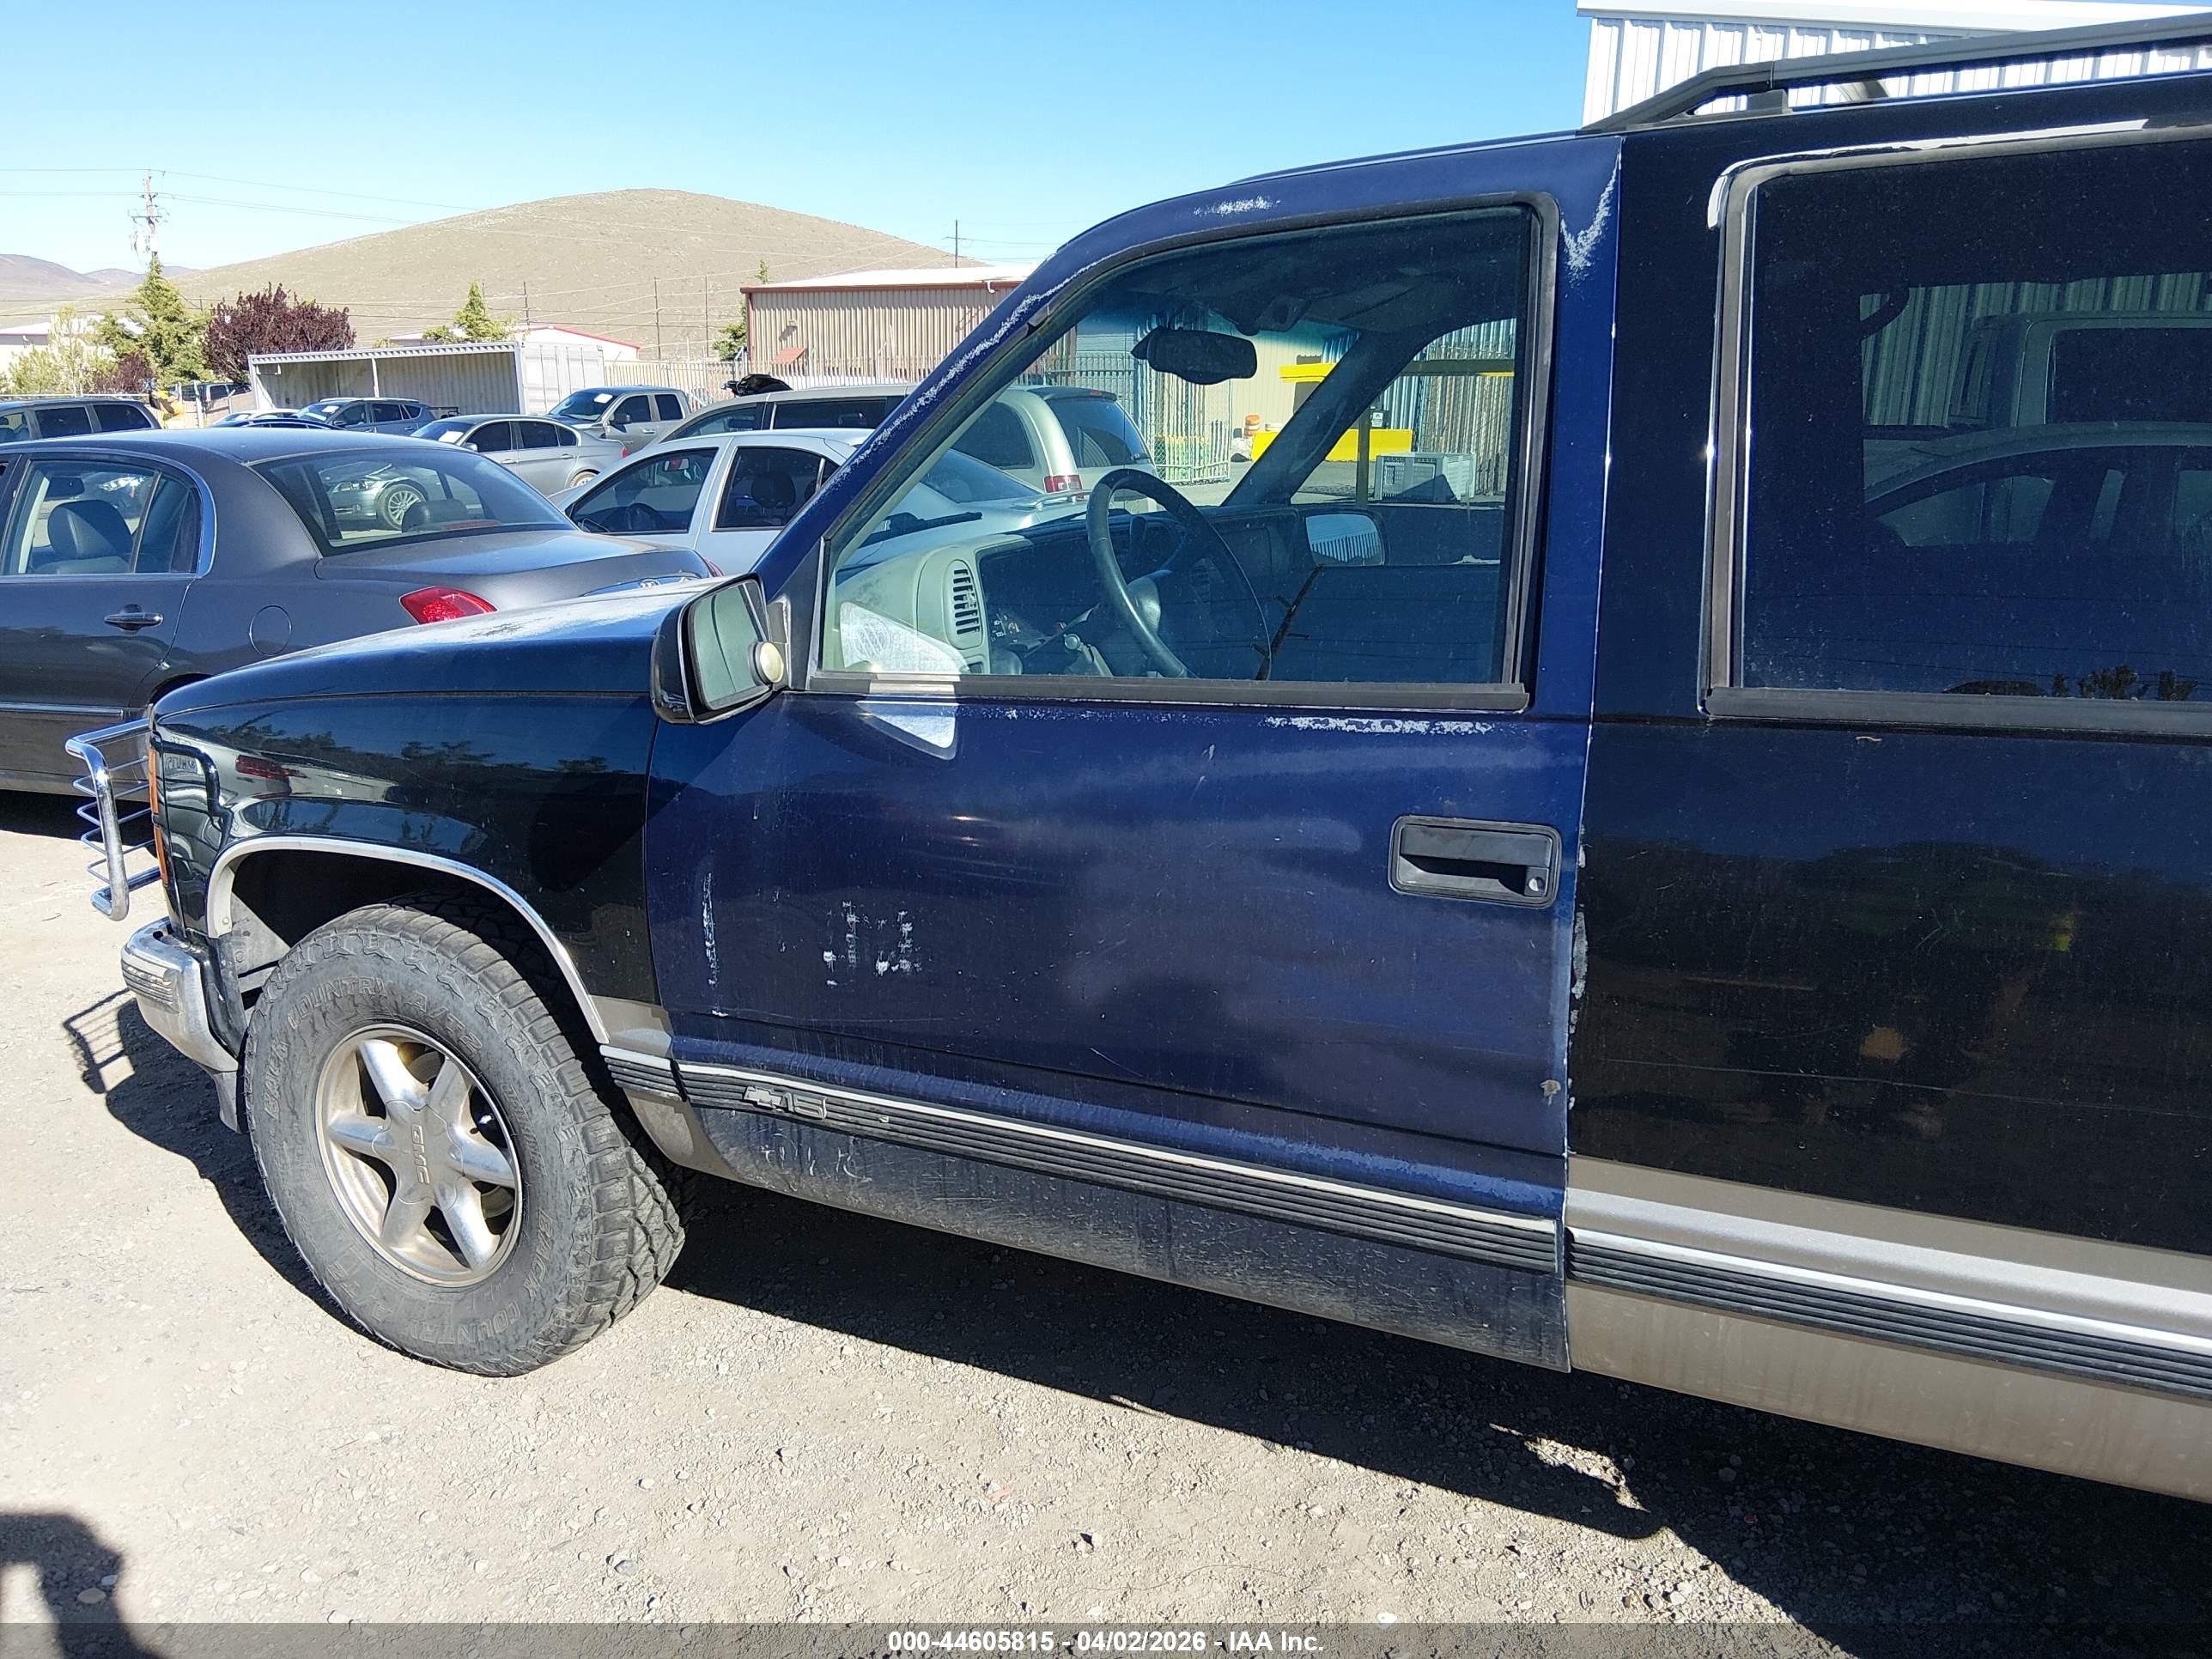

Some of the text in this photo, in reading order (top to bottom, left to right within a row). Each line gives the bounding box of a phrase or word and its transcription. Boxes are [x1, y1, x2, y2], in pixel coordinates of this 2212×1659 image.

[288, 975, 392, 1030] COUNTRY
[411, 1123, 430, 1185] GMC
[522, 1209, 555, 1302] BACK
